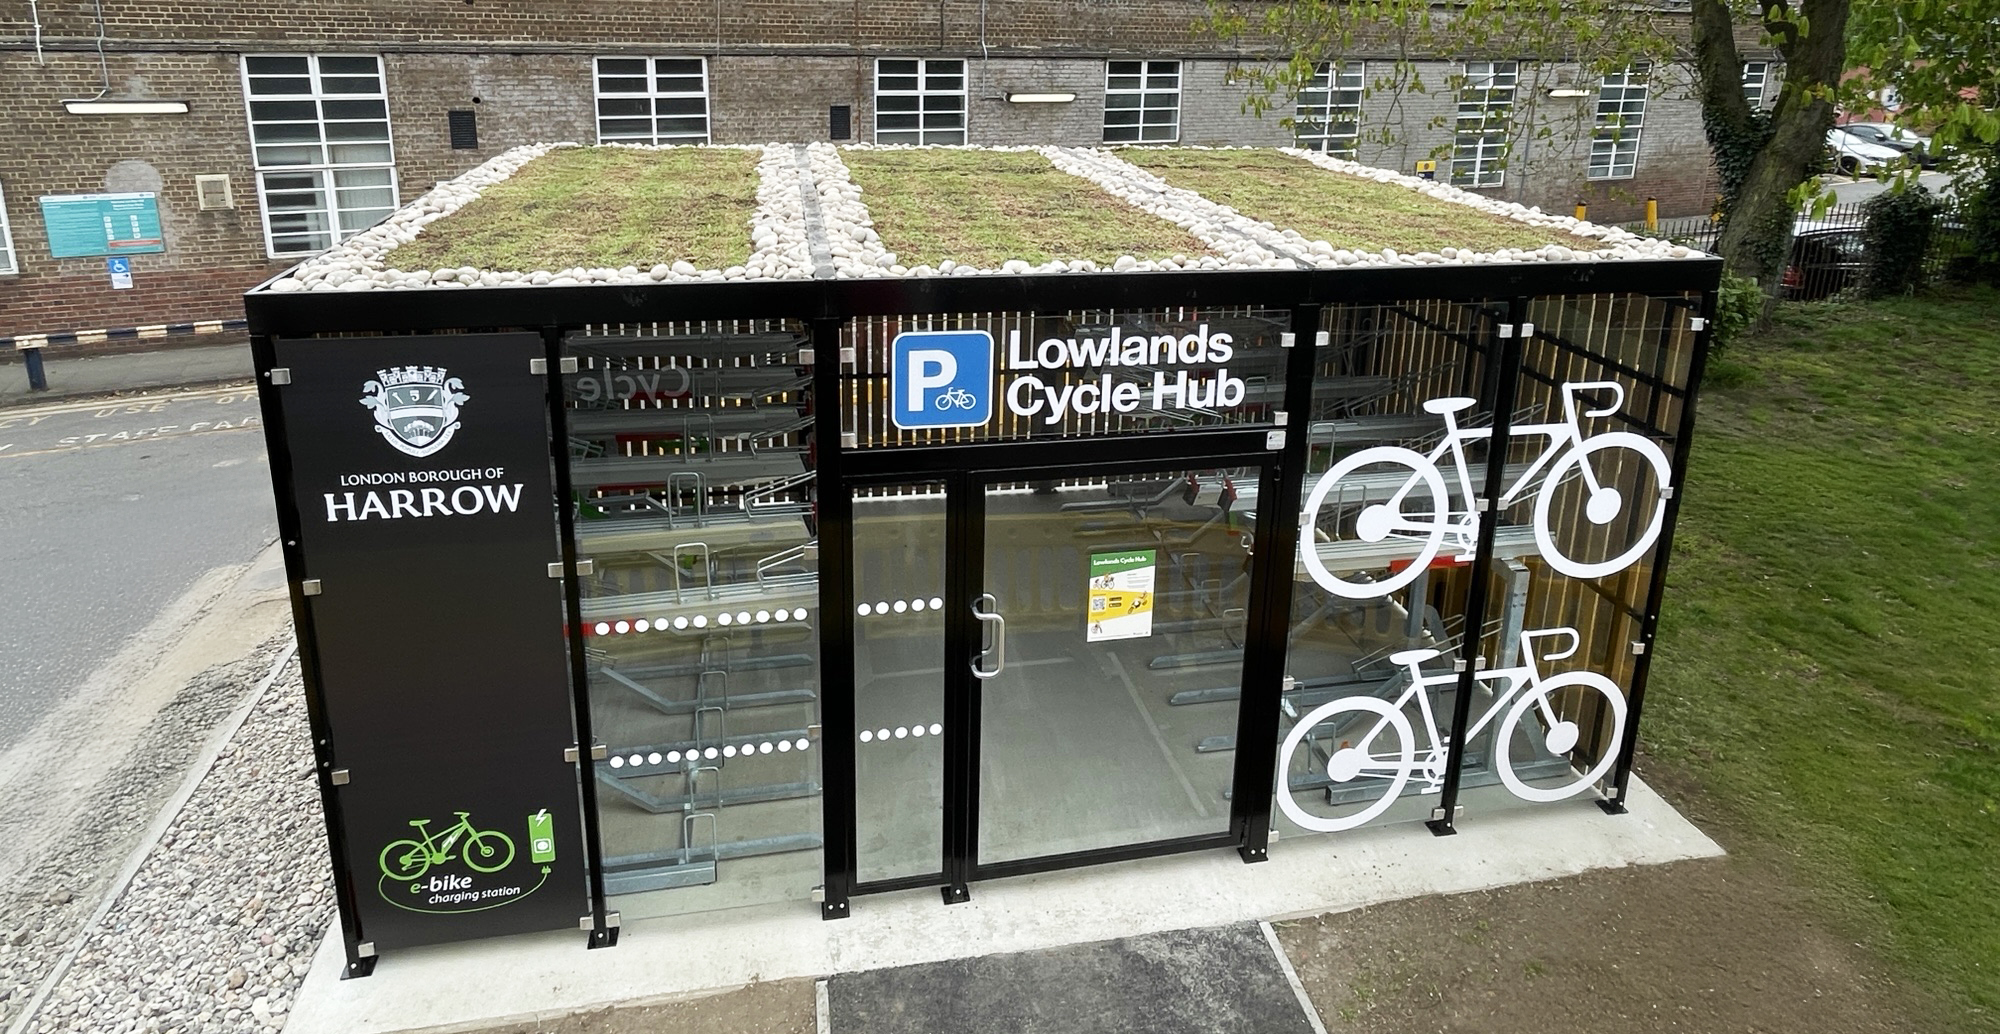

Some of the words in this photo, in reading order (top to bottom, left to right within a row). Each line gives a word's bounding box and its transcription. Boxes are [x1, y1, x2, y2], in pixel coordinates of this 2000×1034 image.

[1010, 324, 1234, 370] Lowlands
[907, 349, 958, 412] P
[1007, 373, 1141, 425] Cycle
[1152, 368, 1246, 410] Hub
[94, 403, 171, 418] USE
[56, 425, 179, 447] STAFF
[340, 472, 405, 486] LONDON
[409, 468, 482, 483] BOROUGH
[485, 467, 504, 479] OF
[323, 483, 524, 522] HARROW
[410, 874, 473, 894] e-bike
[428, 890, 480, 905] charging
[481, 886, 521, 899] station
